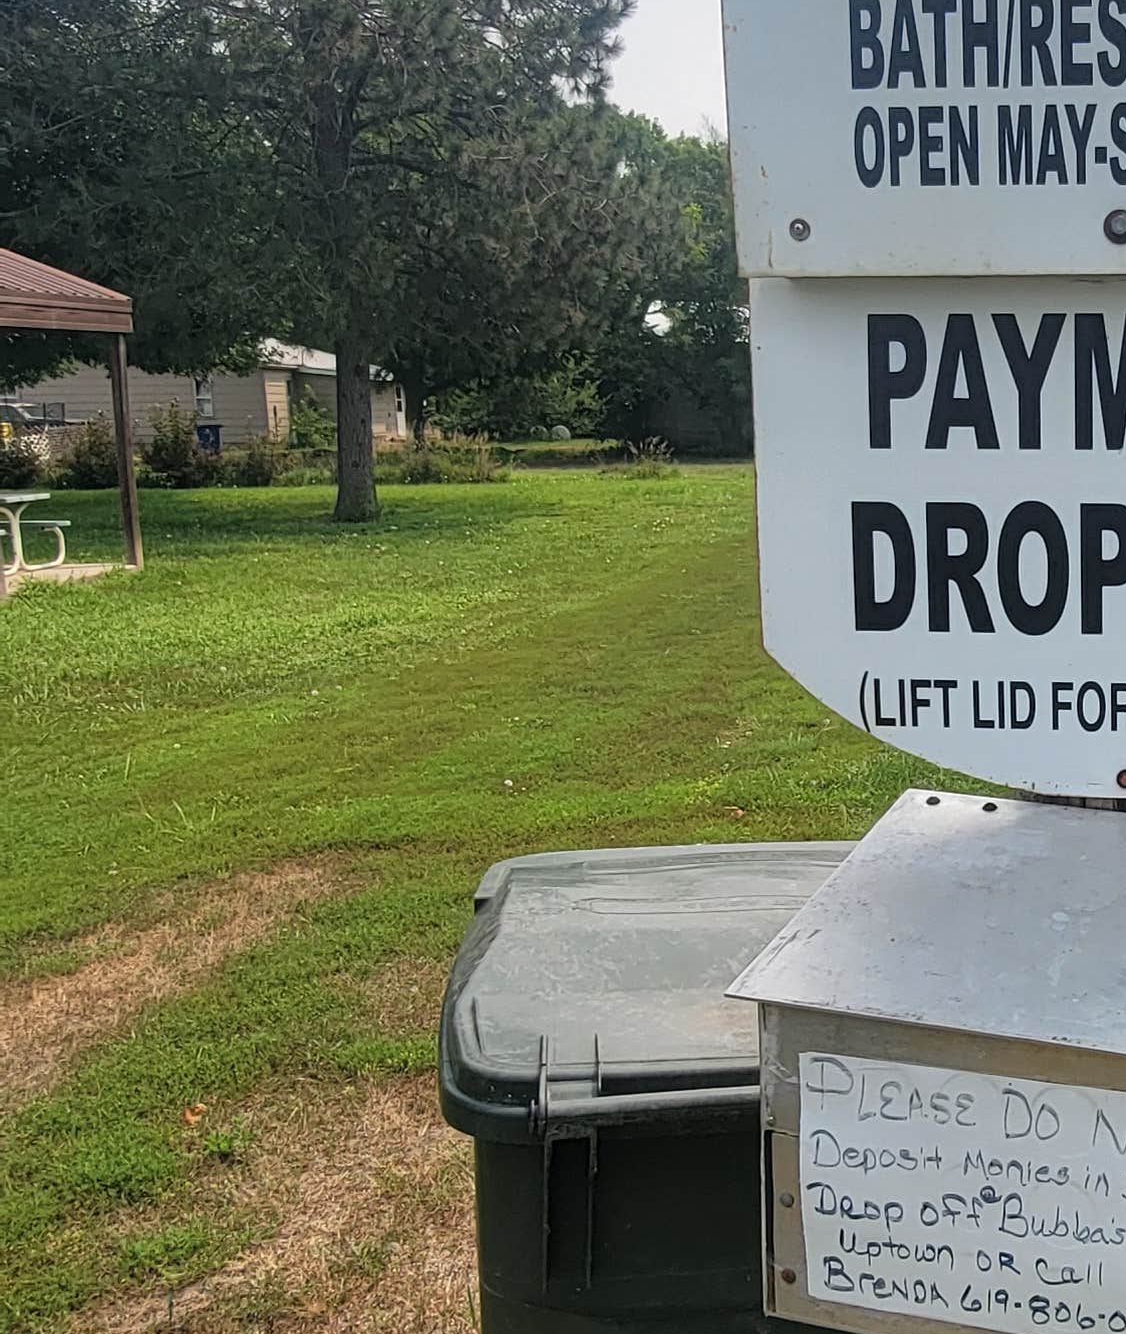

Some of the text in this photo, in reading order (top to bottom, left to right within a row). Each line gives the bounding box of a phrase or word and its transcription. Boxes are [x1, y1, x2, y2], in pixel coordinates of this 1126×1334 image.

[853, 104, 981, 189] OPEN
[859, 671, 958, 734] (LIFT
[972, 679, 1037, 732] LID
[805, 1055, 977, 1128] PLEASE
[1002, 1085, 1061, 1141] DO
[809, 1128, 943, 1175] Deposit
[963, 1148, 1071, 1187] Monies
[1084, 1167, 1109, 1197] in
[998, 1192, 1126, 1245] Bubba's
[838, 1227, 955, 1272] Uptown
[1035, 1257, 1103, 1287] Call
